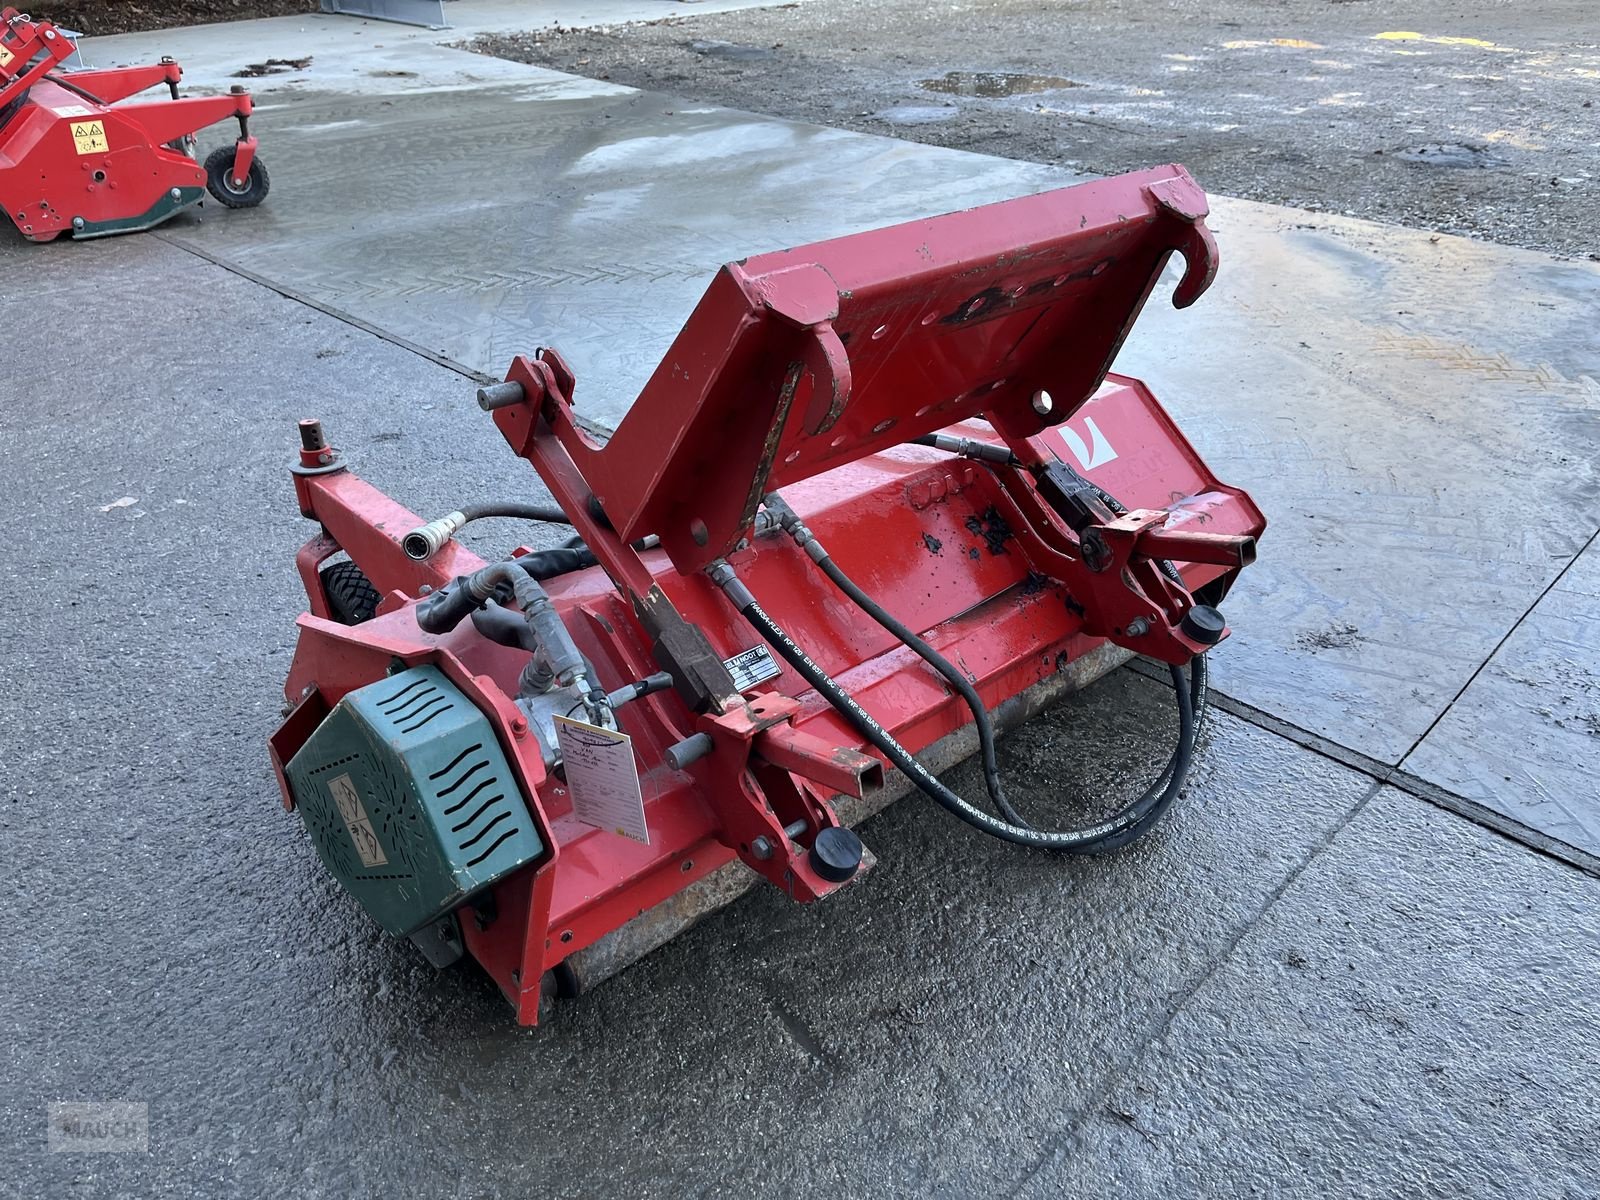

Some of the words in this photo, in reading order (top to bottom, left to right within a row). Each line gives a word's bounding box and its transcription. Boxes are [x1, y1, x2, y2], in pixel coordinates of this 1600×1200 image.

[749, 600, 784, 637] HANSA-FLEX
[783, 636, 794, 647] KP
[791, 645, 803, 657] 120
[802, 656, 813, 667] EN
[846, 697, 858, 710] WP
[865, 716, 879, 730] BAR
